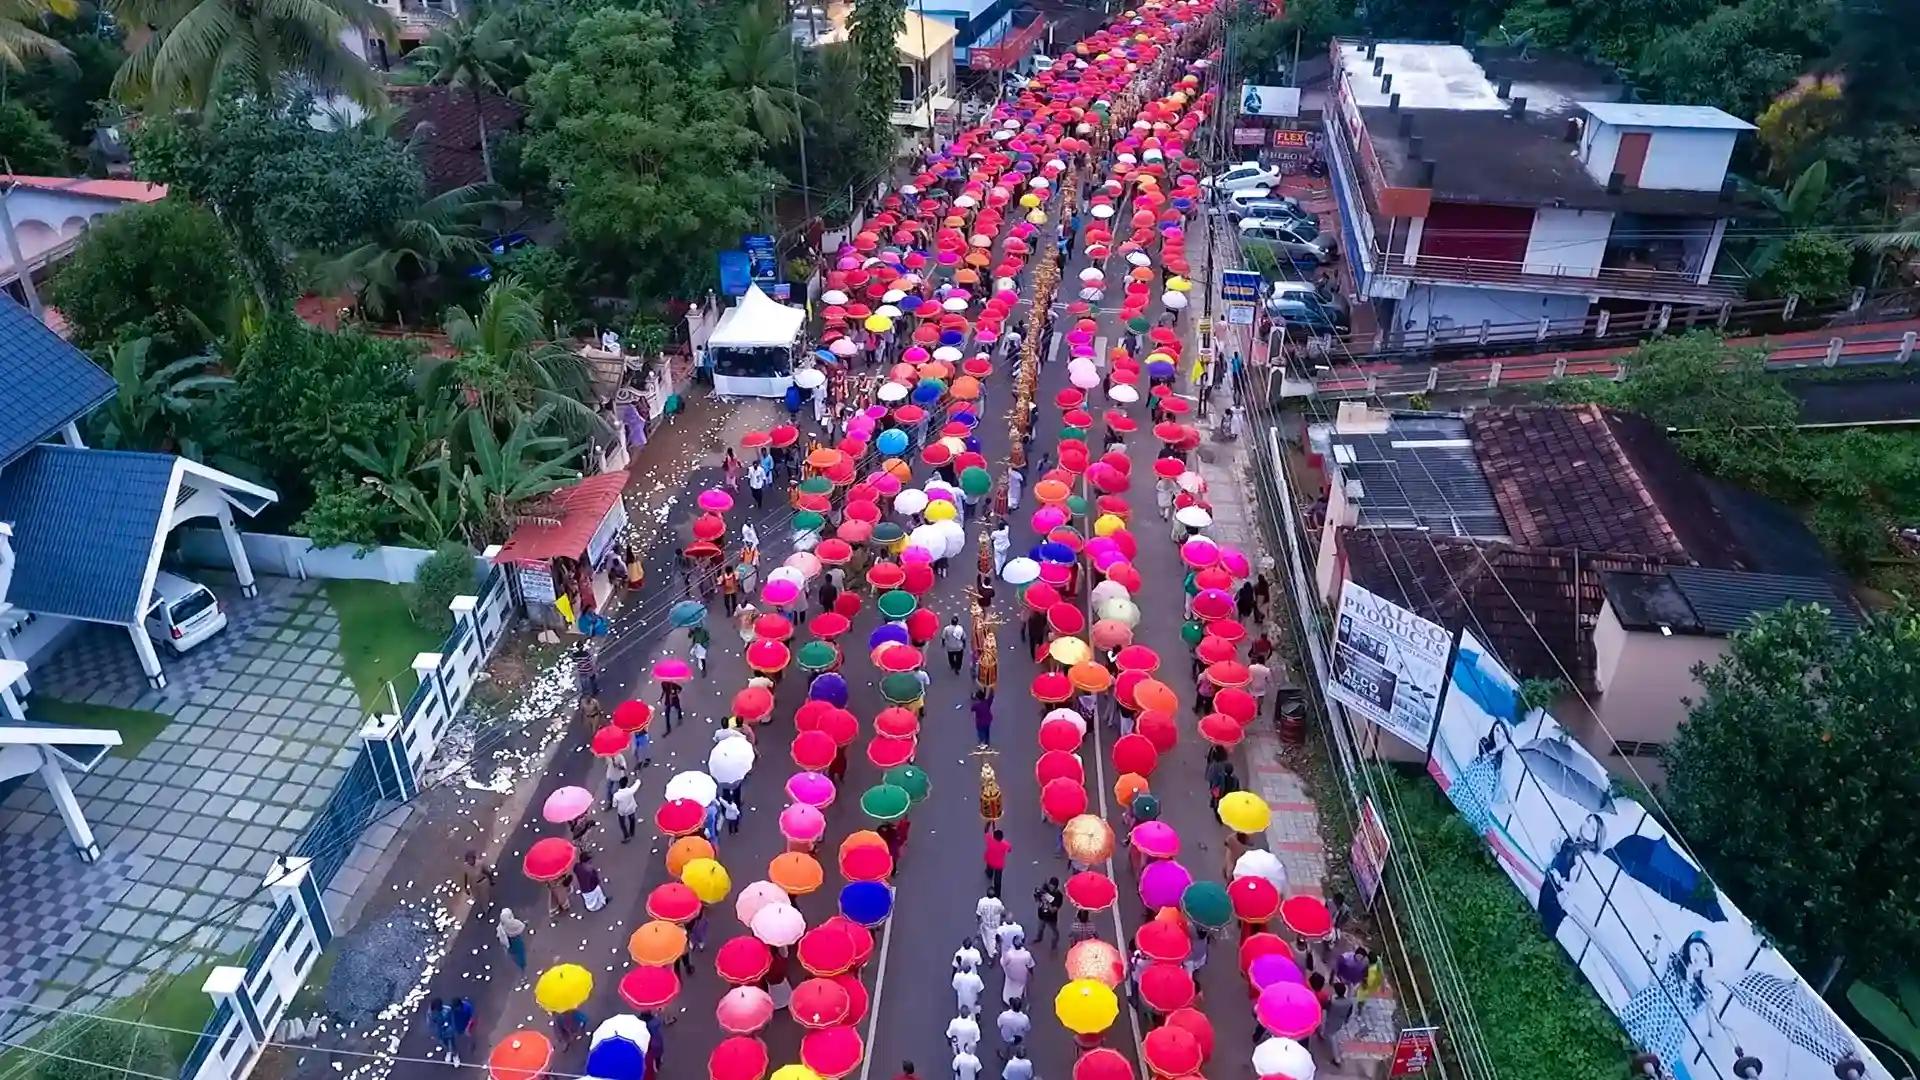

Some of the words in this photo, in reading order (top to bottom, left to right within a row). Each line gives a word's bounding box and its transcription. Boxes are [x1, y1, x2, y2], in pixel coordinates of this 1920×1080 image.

[1277, 132, 1304, 142] FLEX
[1344, 596, 1445, 657] PRODUCTS
[1379, 602, 1446, 645] ALCO
[1342, 667, 1379, 694] ALCO
